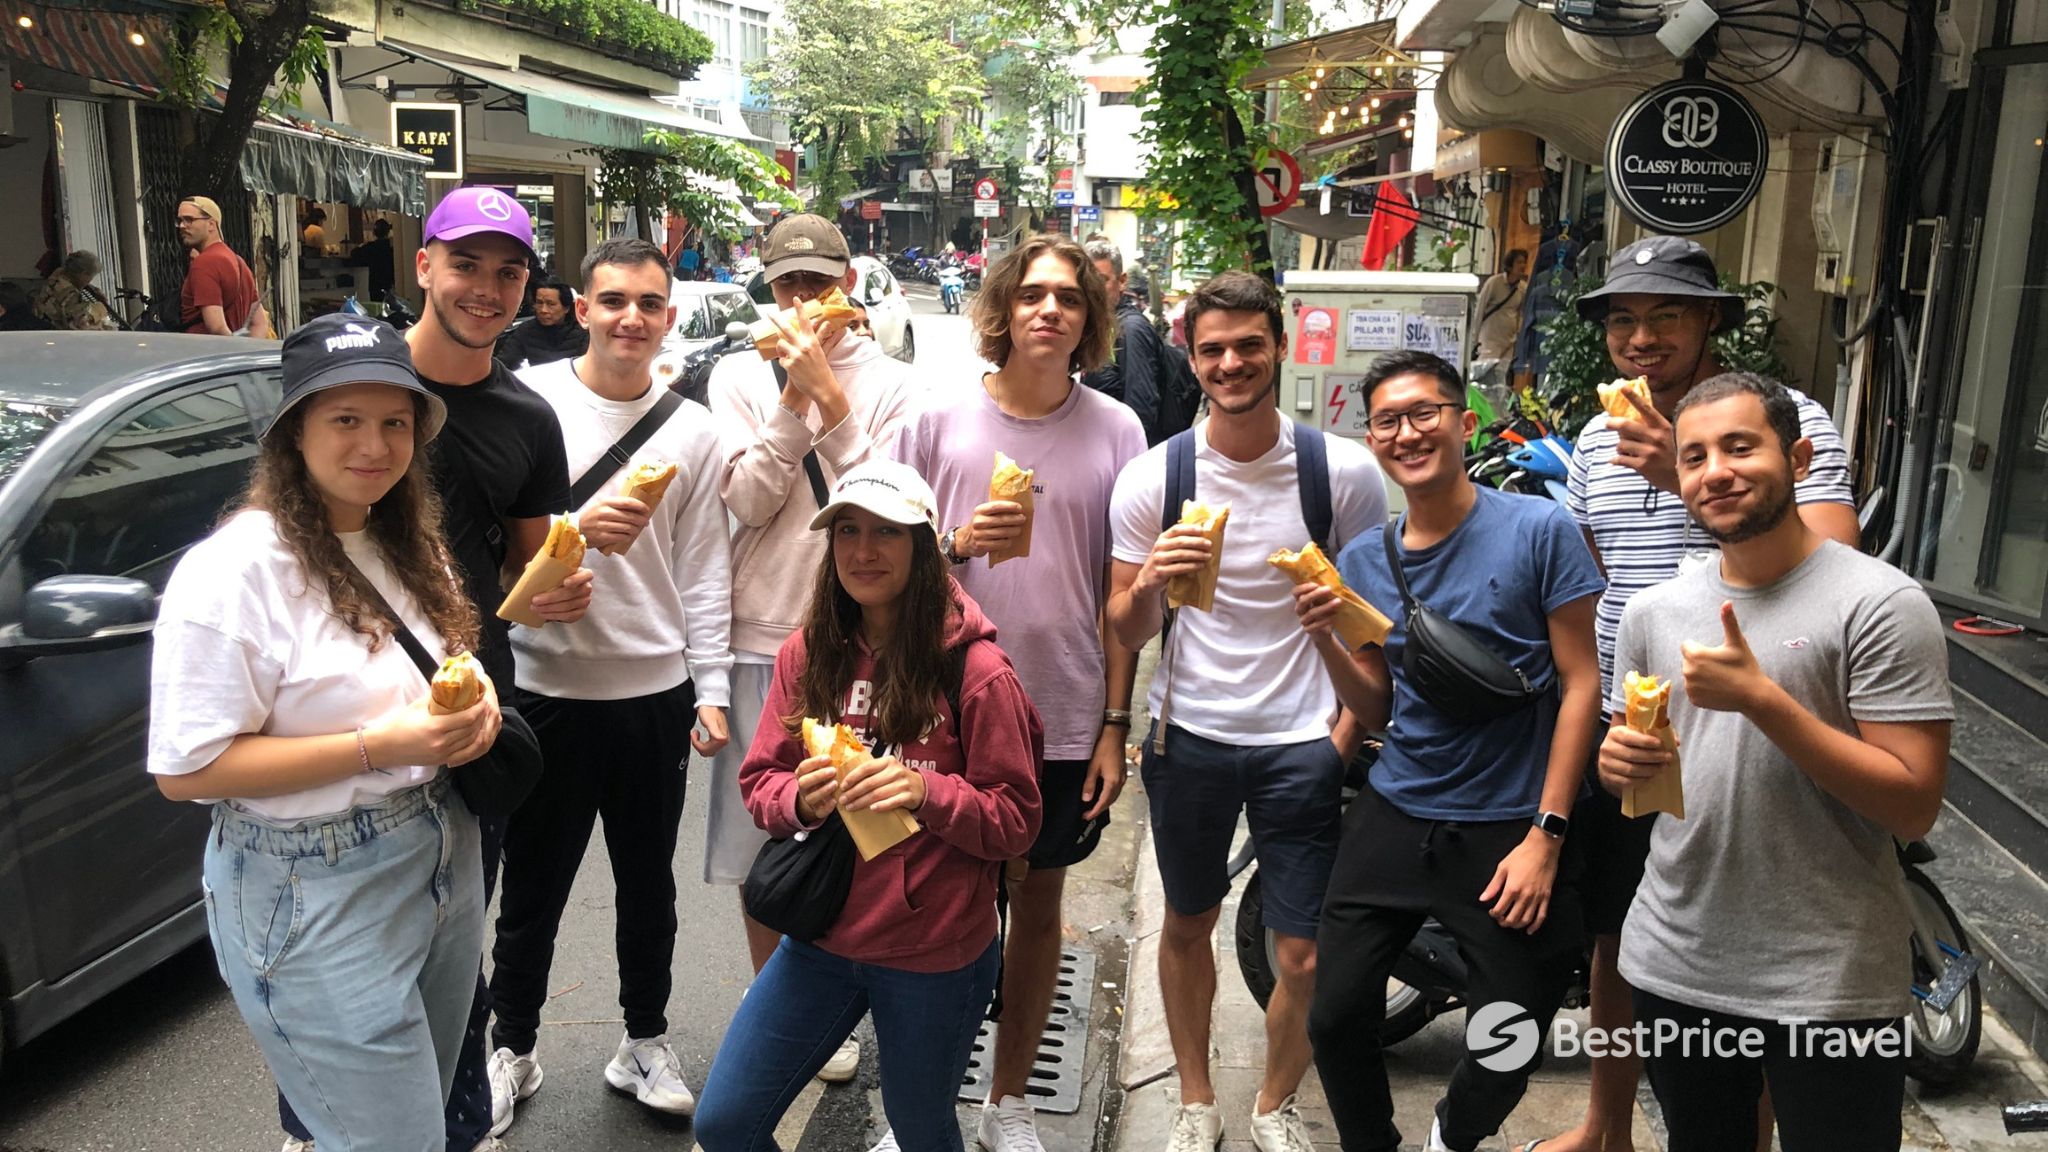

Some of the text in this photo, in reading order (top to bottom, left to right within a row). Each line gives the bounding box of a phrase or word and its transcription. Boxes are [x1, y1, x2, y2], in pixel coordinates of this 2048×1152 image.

[1666, 182, 1707, 195] HOTEL
[1354, 326, 1384, 334] PILLAR
[326, 334, 374, 353] PUMA
[837, 478, 900, 492] Champion
